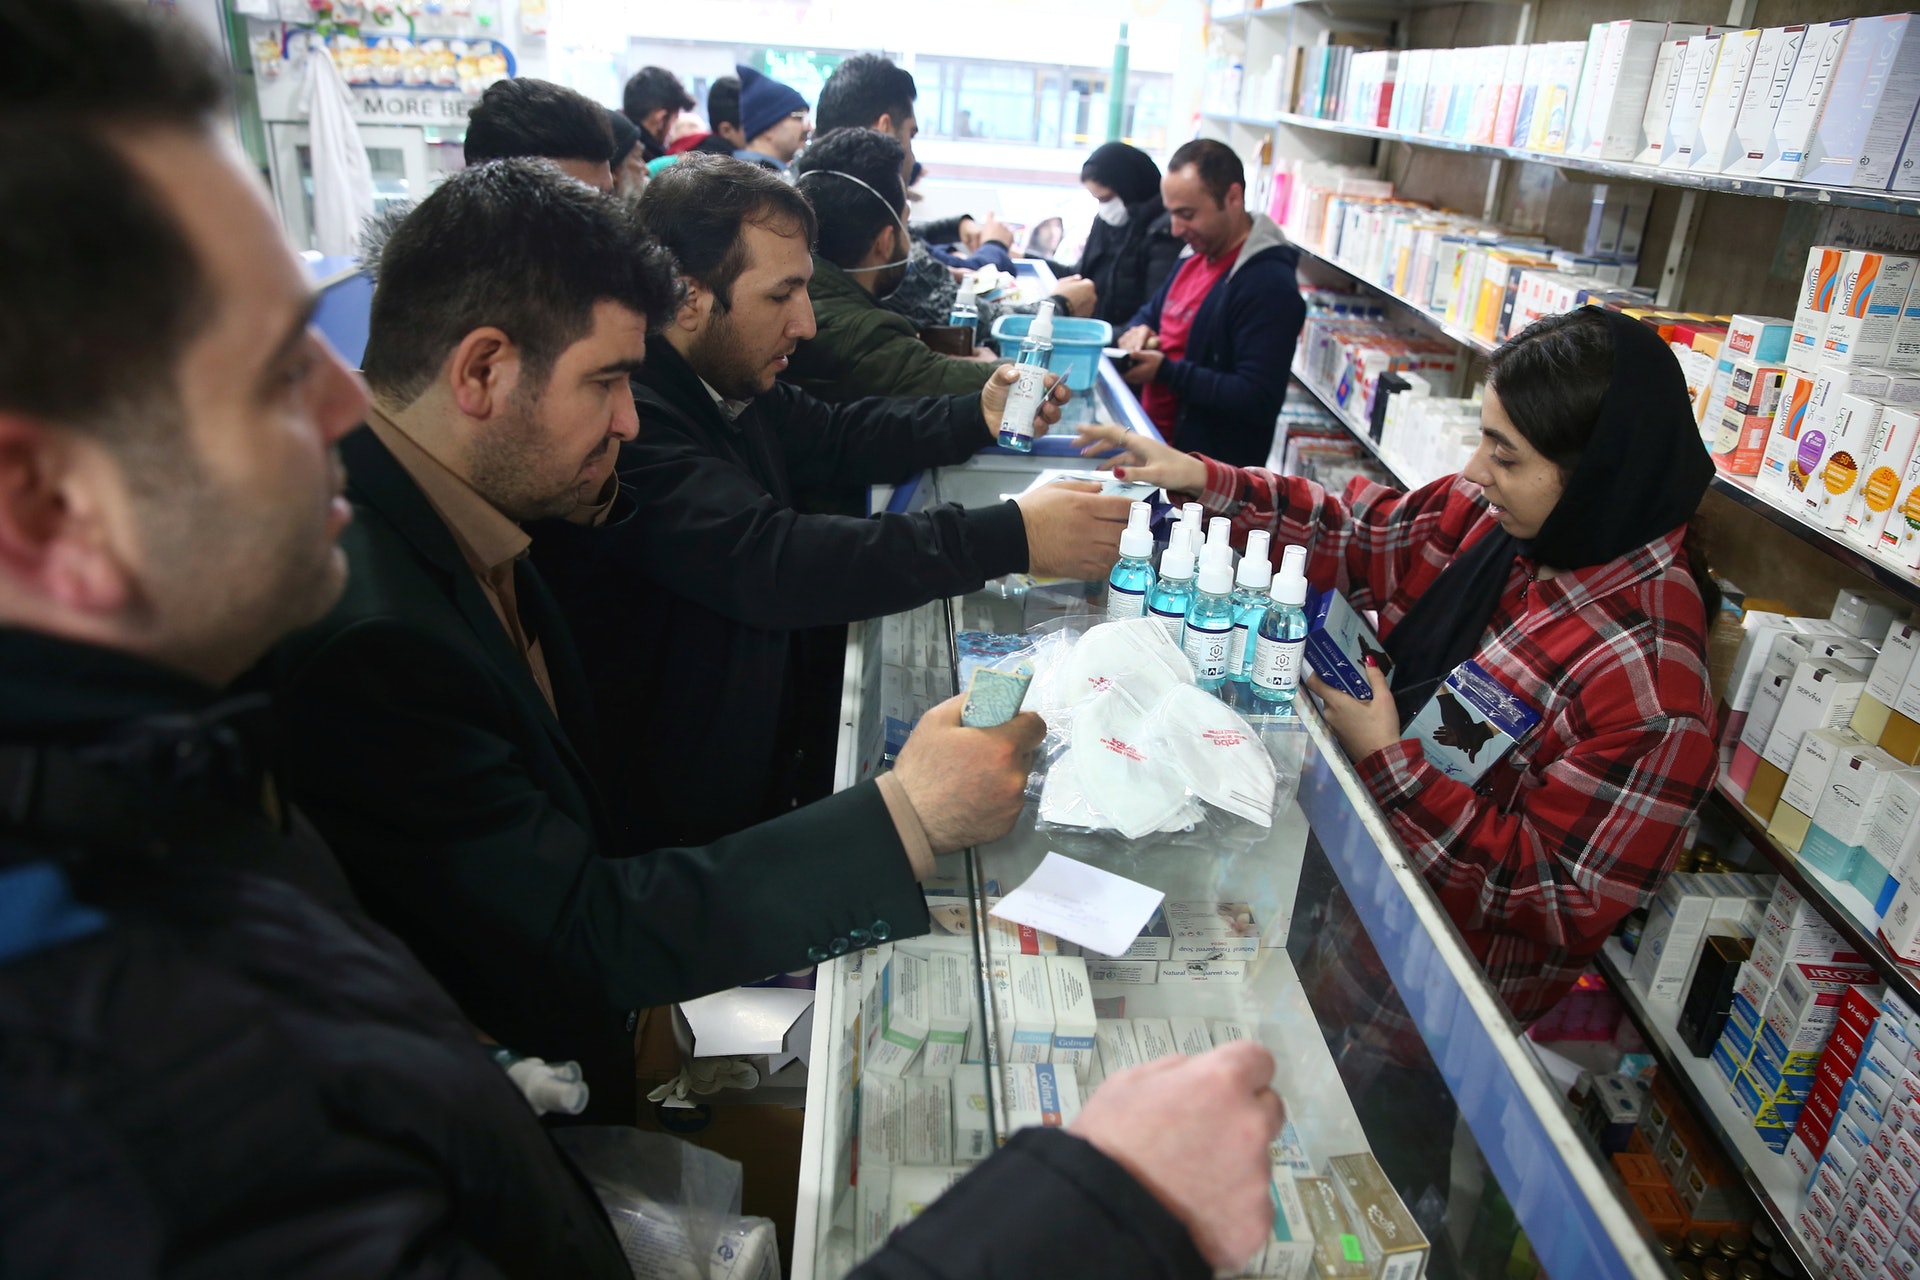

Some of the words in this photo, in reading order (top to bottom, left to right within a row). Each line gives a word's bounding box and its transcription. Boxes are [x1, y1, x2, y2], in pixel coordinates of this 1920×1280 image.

[1770, 35, 1800, 109] FULICA
[1808, 30, 1844, 107] FULICA
[363, 97, 431, 115] MORE
[1804, 267, 1820, 310] Laminin
[1839, 272, 1858, 316] Laminin
[1808, 968, 1871, 983] IROX
[1058, 1039, 1090, 1047] Golmar
[1039, 1072, 1054, 1111] Golmar
